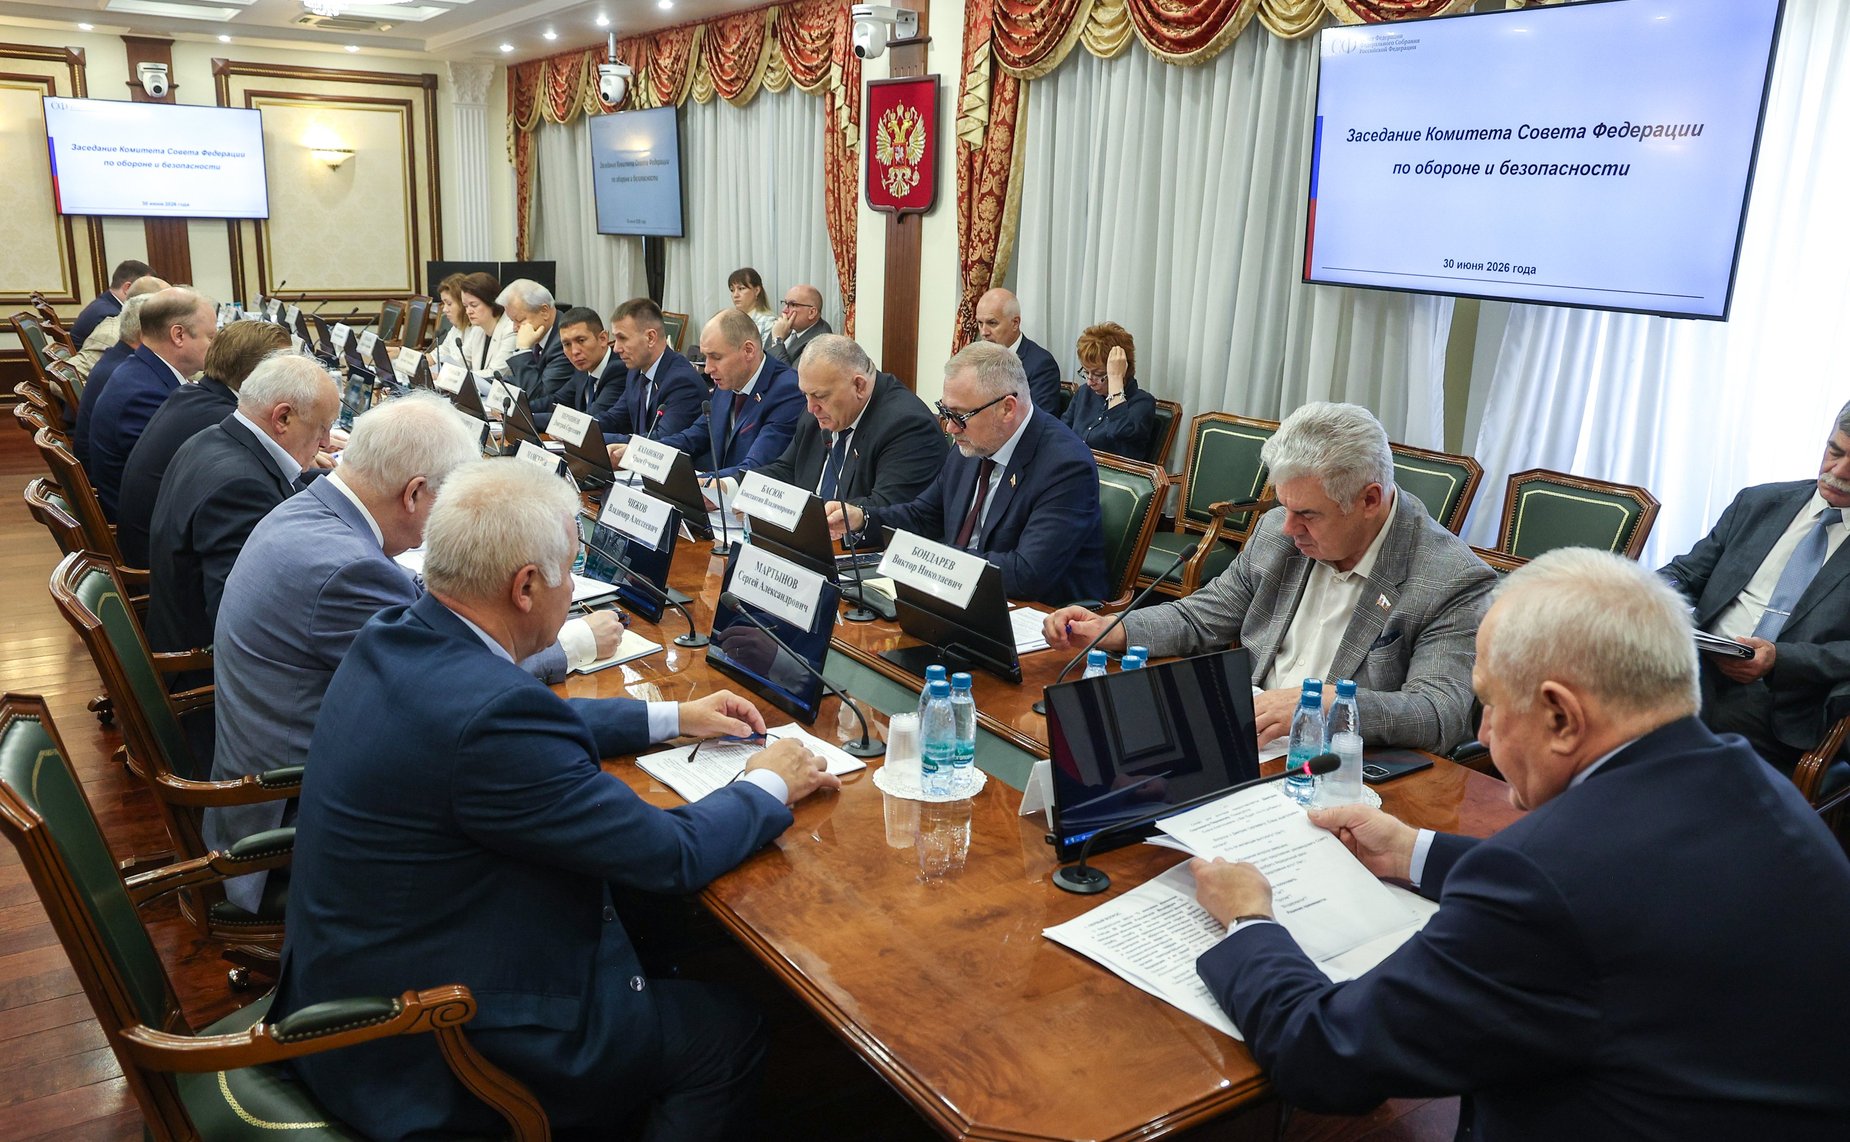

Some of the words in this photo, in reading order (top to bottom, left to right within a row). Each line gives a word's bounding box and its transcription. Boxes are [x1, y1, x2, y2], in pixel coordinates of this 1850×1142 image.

[1389, 45, 1417, 53] Федерации
[1346, 127, 1422, 142] Заседание
[1425, 126, 1513, 141] Комитета
[1517, 124, 1587, 140] Совета
[1592, 121, 1705, 142] Федерации
[71, 143, 117, 152] Заседание
[119, 146, 165, 154] Комитета
[167, 148, 199, 156] Совета
[201, 149, 246, 158] Федерации
[116, 160, 153, 168] обороне
[161, 162, 221, 170] безопасности
[1392, 163, 1411, 175] по
[1414, 160, 1481, 179] обороне
[1484, 163, 1495, 175] и
[1499, 159, 1631, 176] безопасности
[1443, 258, 1455, 269] 30
[1456, 262, 1484, 271] июня
[1486, 261, 1510, 273] 2026
[1512, 265, 1537, 276] года
[761, 484, 785, 500] БАСЮК
[627, 497, 649, 514] ЧИЖОВ
[740, 489, 764, 504] Константин
[763, 497, 797, 516] Владимирович
[607, 503, 631, 522] Владимир
[911, 546, 956, 571] БОНДАРЕВ
[755, 560, 799, 590] МАРТЫНОВ
[891, 553, 917, 574] Виктор
[917, 564, 963, 591] Николаевич
[737, 569, 759, 588] Сергей
[758, 581, 809, 613] Александрович
